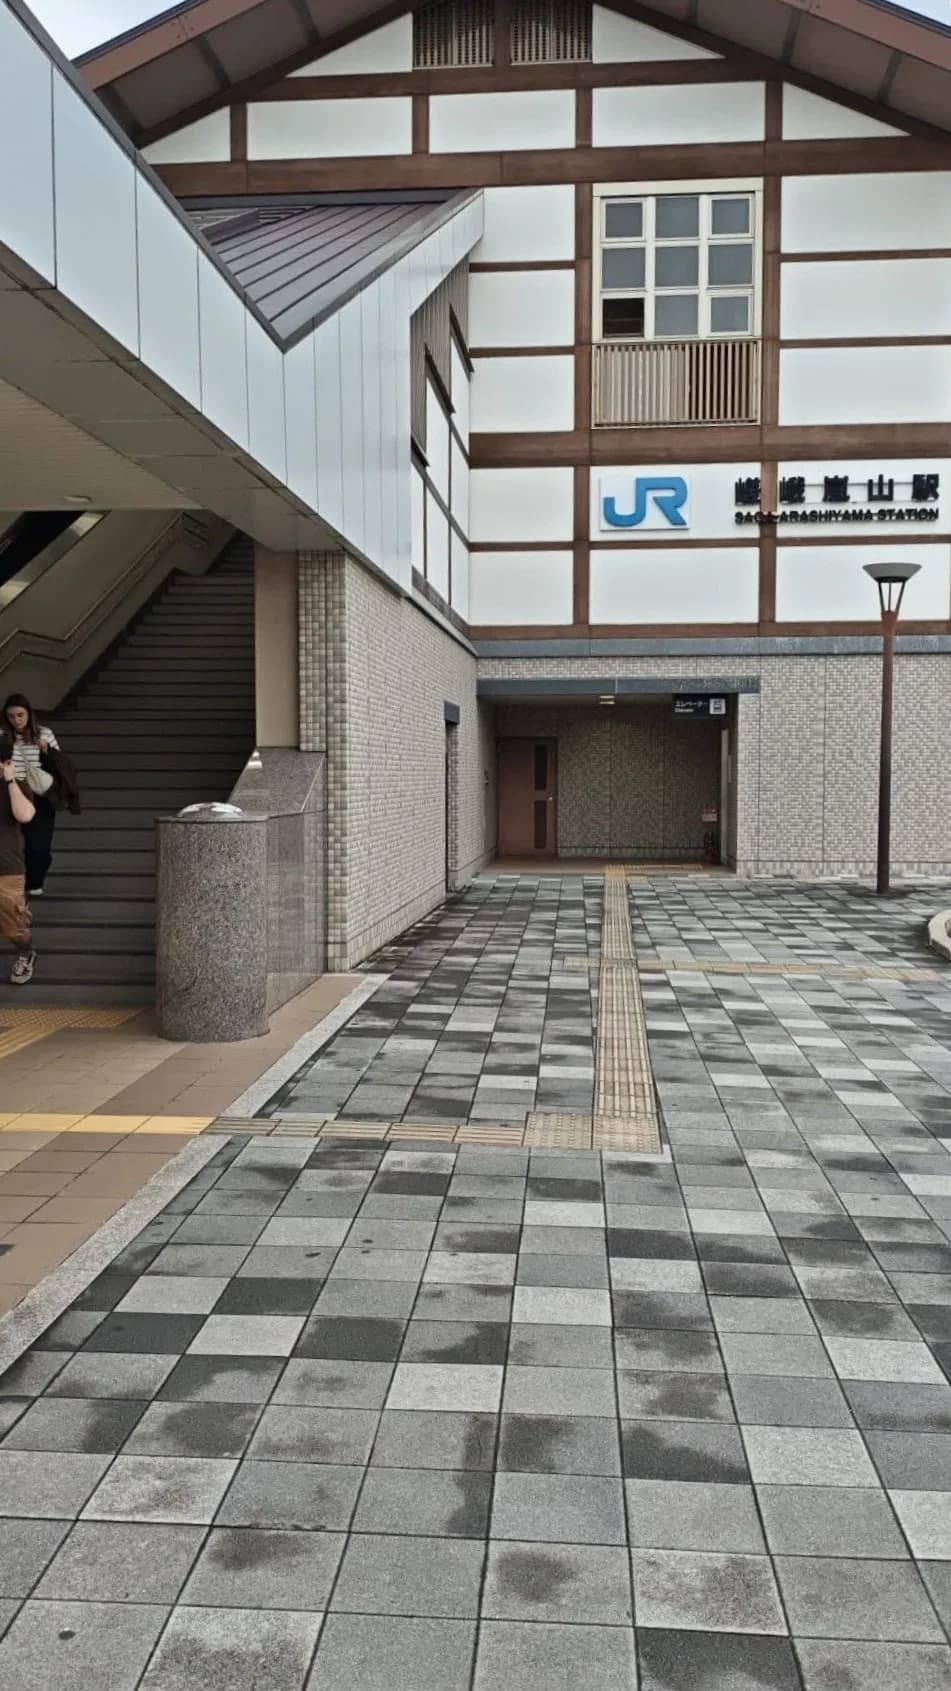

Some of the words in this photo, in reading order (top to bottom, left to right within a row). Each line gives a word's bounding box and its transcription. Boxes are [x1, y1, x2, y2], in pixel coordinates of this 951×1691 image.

[603, 476, 688, 528] JR
[735, 474, 940, 505] 嵯峨嵐山駅
[877, 507, 940, 522] STATION
